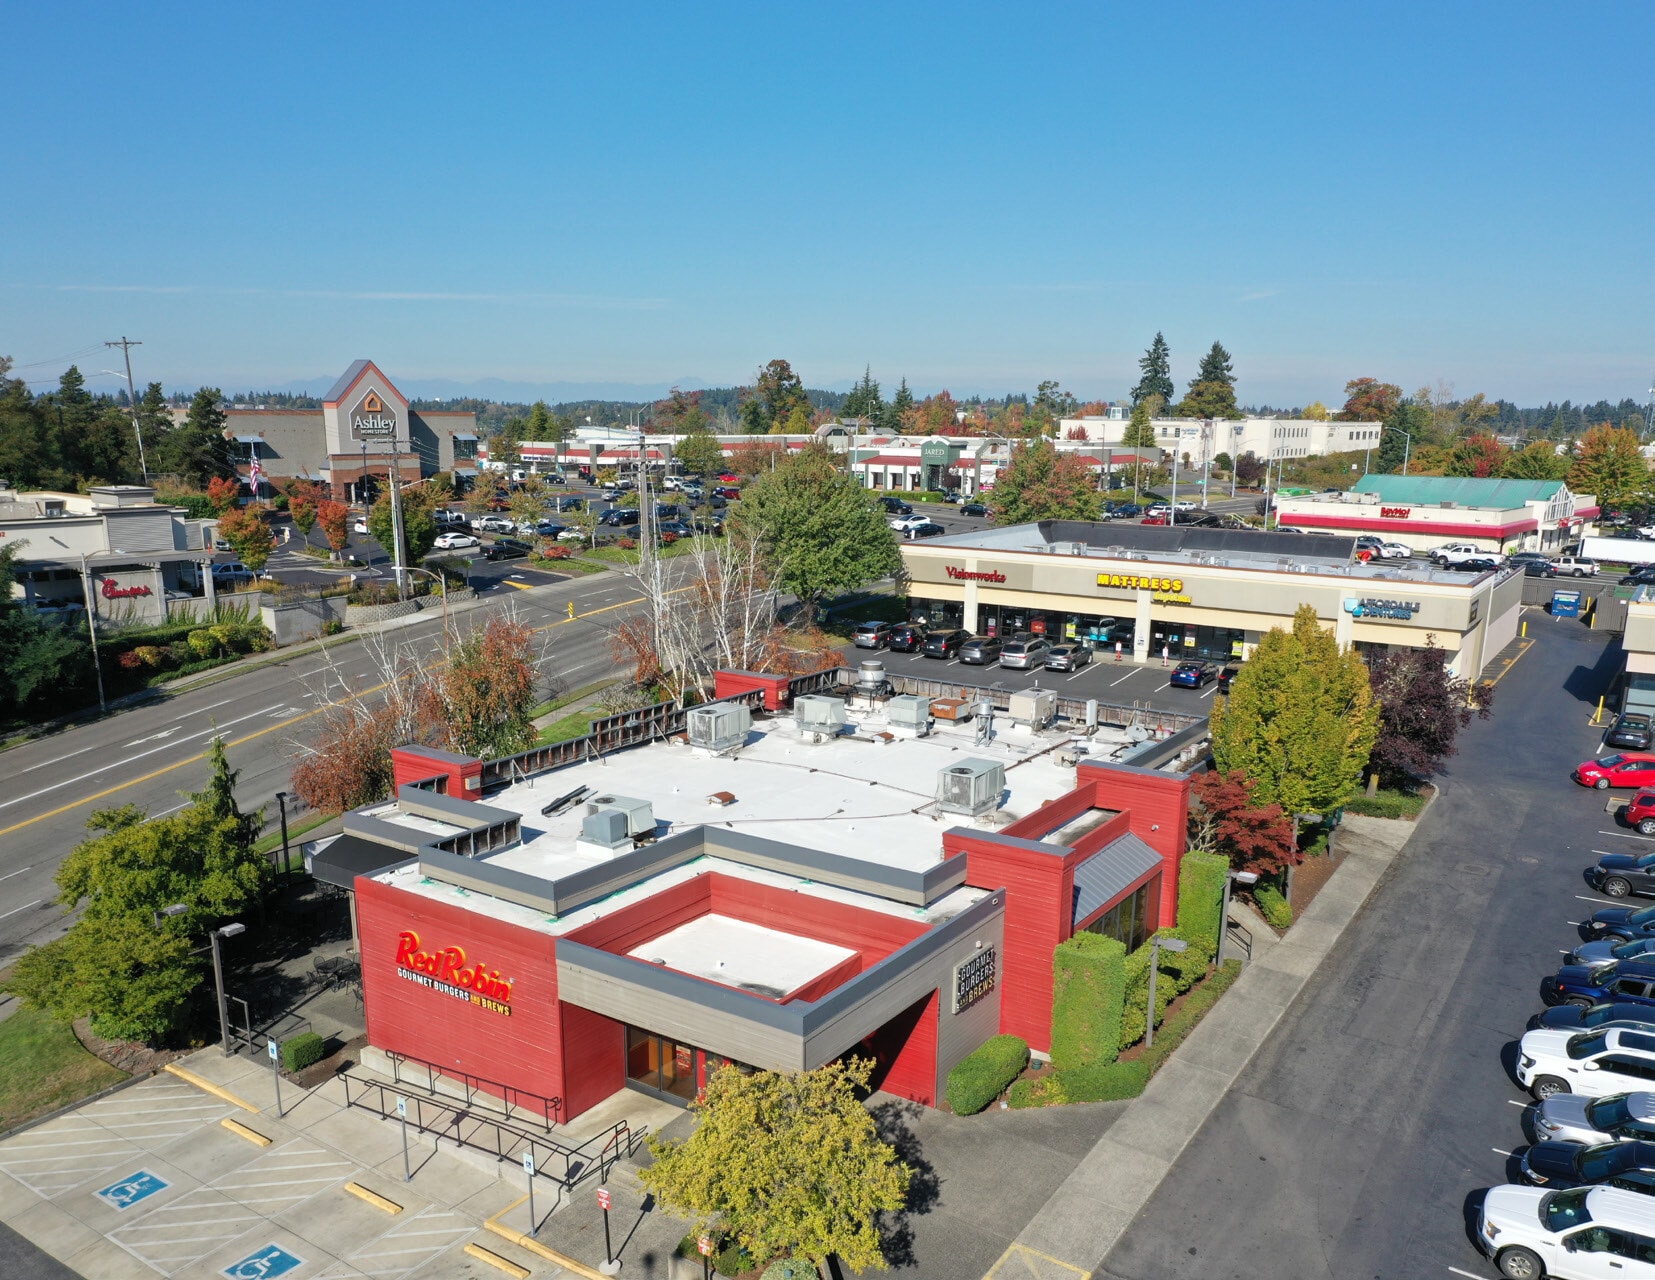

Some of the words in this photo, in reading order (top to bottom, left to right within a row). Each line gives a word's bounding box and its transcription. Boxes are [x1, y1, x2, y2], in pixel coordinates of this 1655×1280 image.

[354, 414, 396, 432] Ashley
[924, 448, 945, 456] JARED
[945, 565, 1007, 583] Visionworks
[1097, 573, 1183, 592] MATTRESS
[1358, 598, 1420, 612] AFFORDABLE
[1363, 606, 1413, 619] DENTURES
[396, 930, 445, 976] Red
[440, 945, 512, 1003] Robin
[961, 949, 994, 980] GOURMET
[960, 962, 994, 995] BURGERS
[397, 967, 433, 988] GOURMET
[434, 981, 470, 1002] BURGERS
[481, 998, 510, 1016] BREWS
[968, 976, 993, 1003] BREWS
